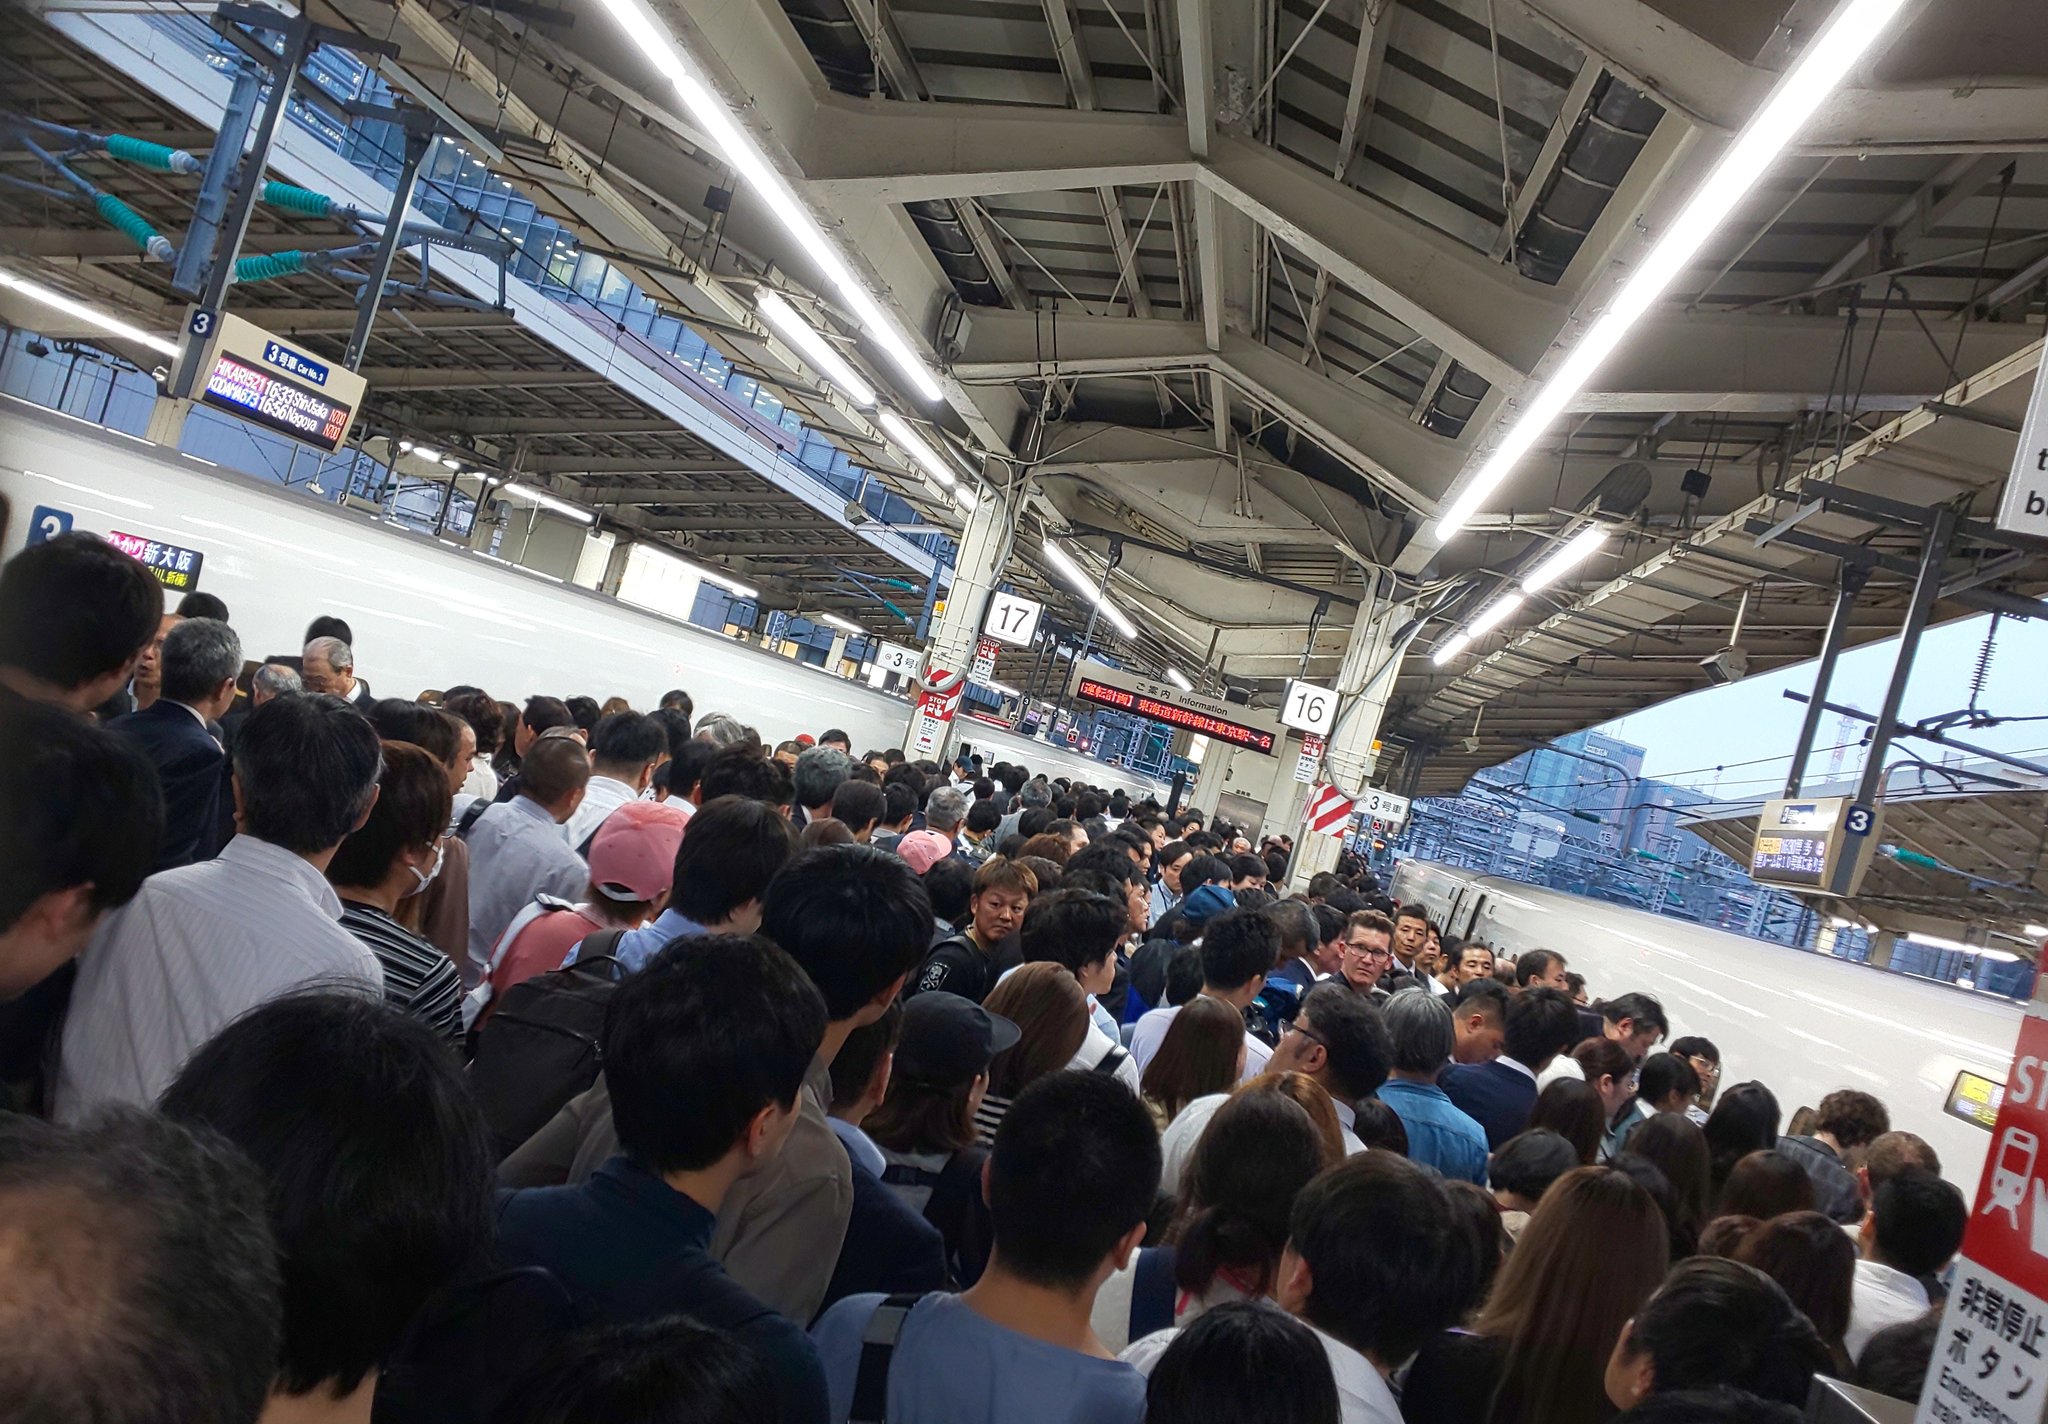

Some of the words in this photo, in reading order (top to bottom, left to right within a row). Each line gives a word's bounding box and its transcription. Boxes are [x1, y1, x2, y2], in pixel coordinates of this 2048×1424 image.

[194, 313, 210, 333] 3
[318, 373, 324, 382] 3
[257, 395, 290, 420] 16:56
[285, 407, 318, 432] Nagoya
[2024, 490, 2048, 515] b
[1000, 604, 1030, 633] 17
[983, 639, 1000, 649] STOP
[929, 695, 947, 706] STOP
[1023, 697, 1030, 705] 3
[1136, 681, 1171, 700] ご案内
[1178, 695, 1228, 716] Information
[1297, 692, 1326, 723] 16
[1370, 795, 1403, 815] 3号車
[1849, 811, 1869, 831] 3
[1601, 832, 1612, 842] 15
[1959, 1277, 2046, 1359] 非常停止
[1947, 1327, 2033, 1400] ボタン
